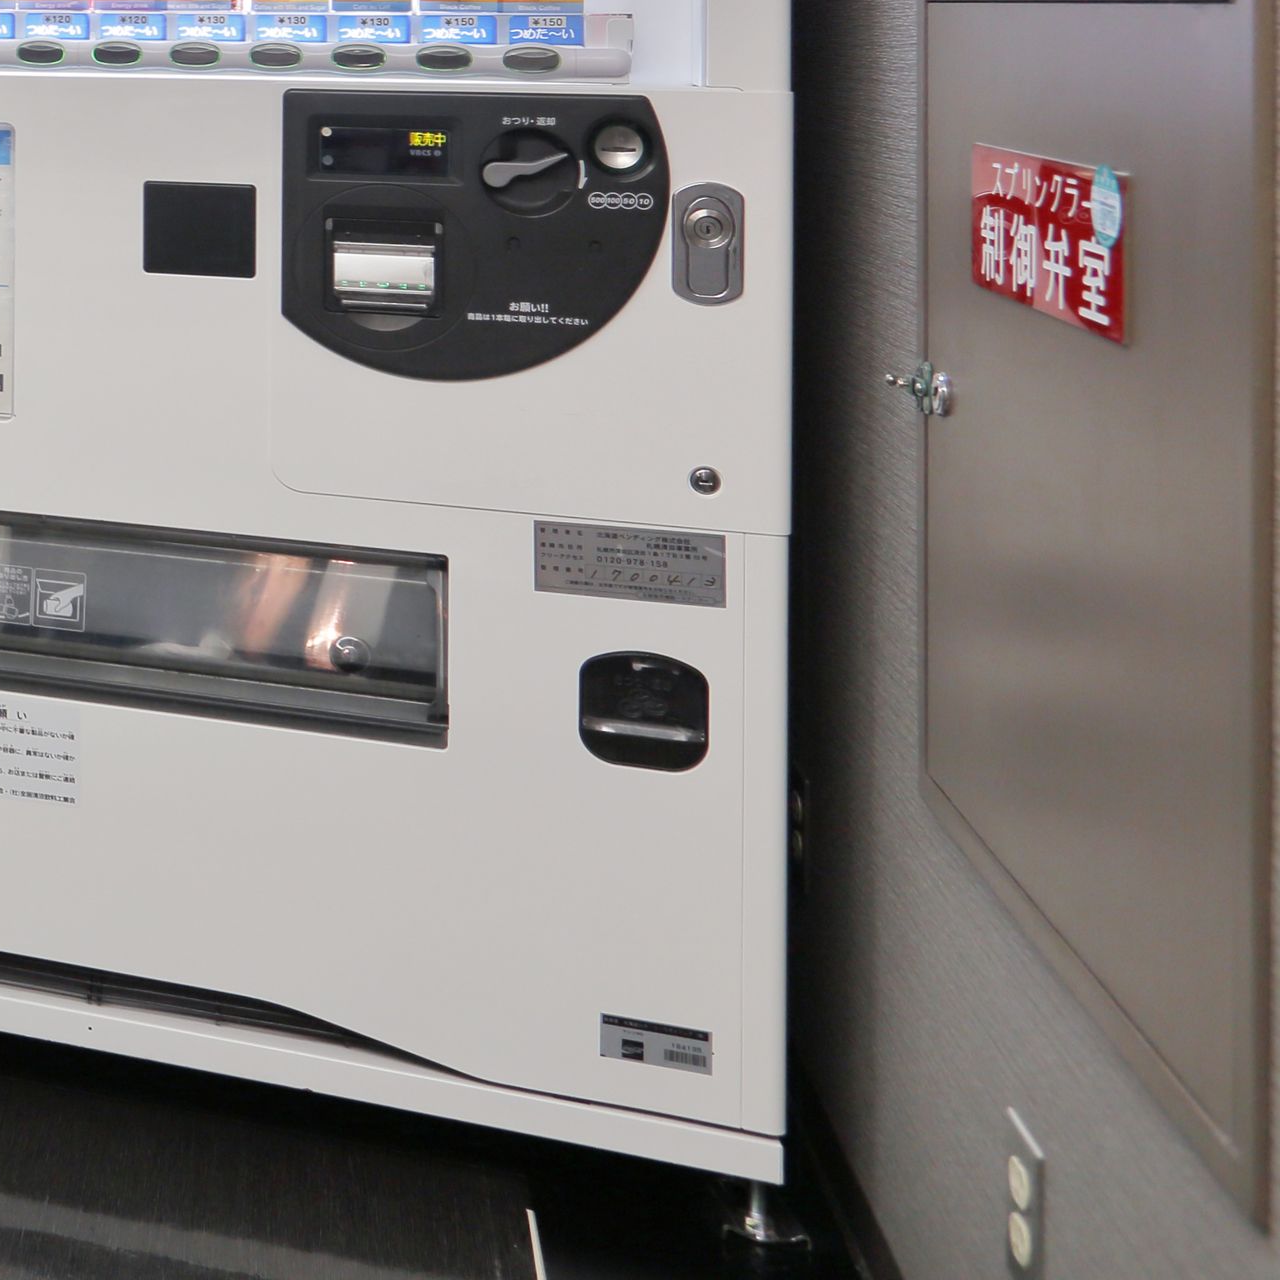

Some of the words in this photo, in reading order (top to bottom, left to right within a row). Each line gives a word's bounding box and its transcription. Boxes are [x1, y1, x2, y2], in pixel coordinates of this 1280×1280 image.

[45, 15, 71, 24] ¥120
[278, 16, 306, 25] ¥130
[360, 17, 389, 26] ¥130
[532, 17, 563, 27] ¥150
[502, 117, 556, 126] おつり・返却
[409, 132, 446, 147] 販売中
[590, 196, 605, 204] 500
[980, 205, 1110, 326] 制御弁室
